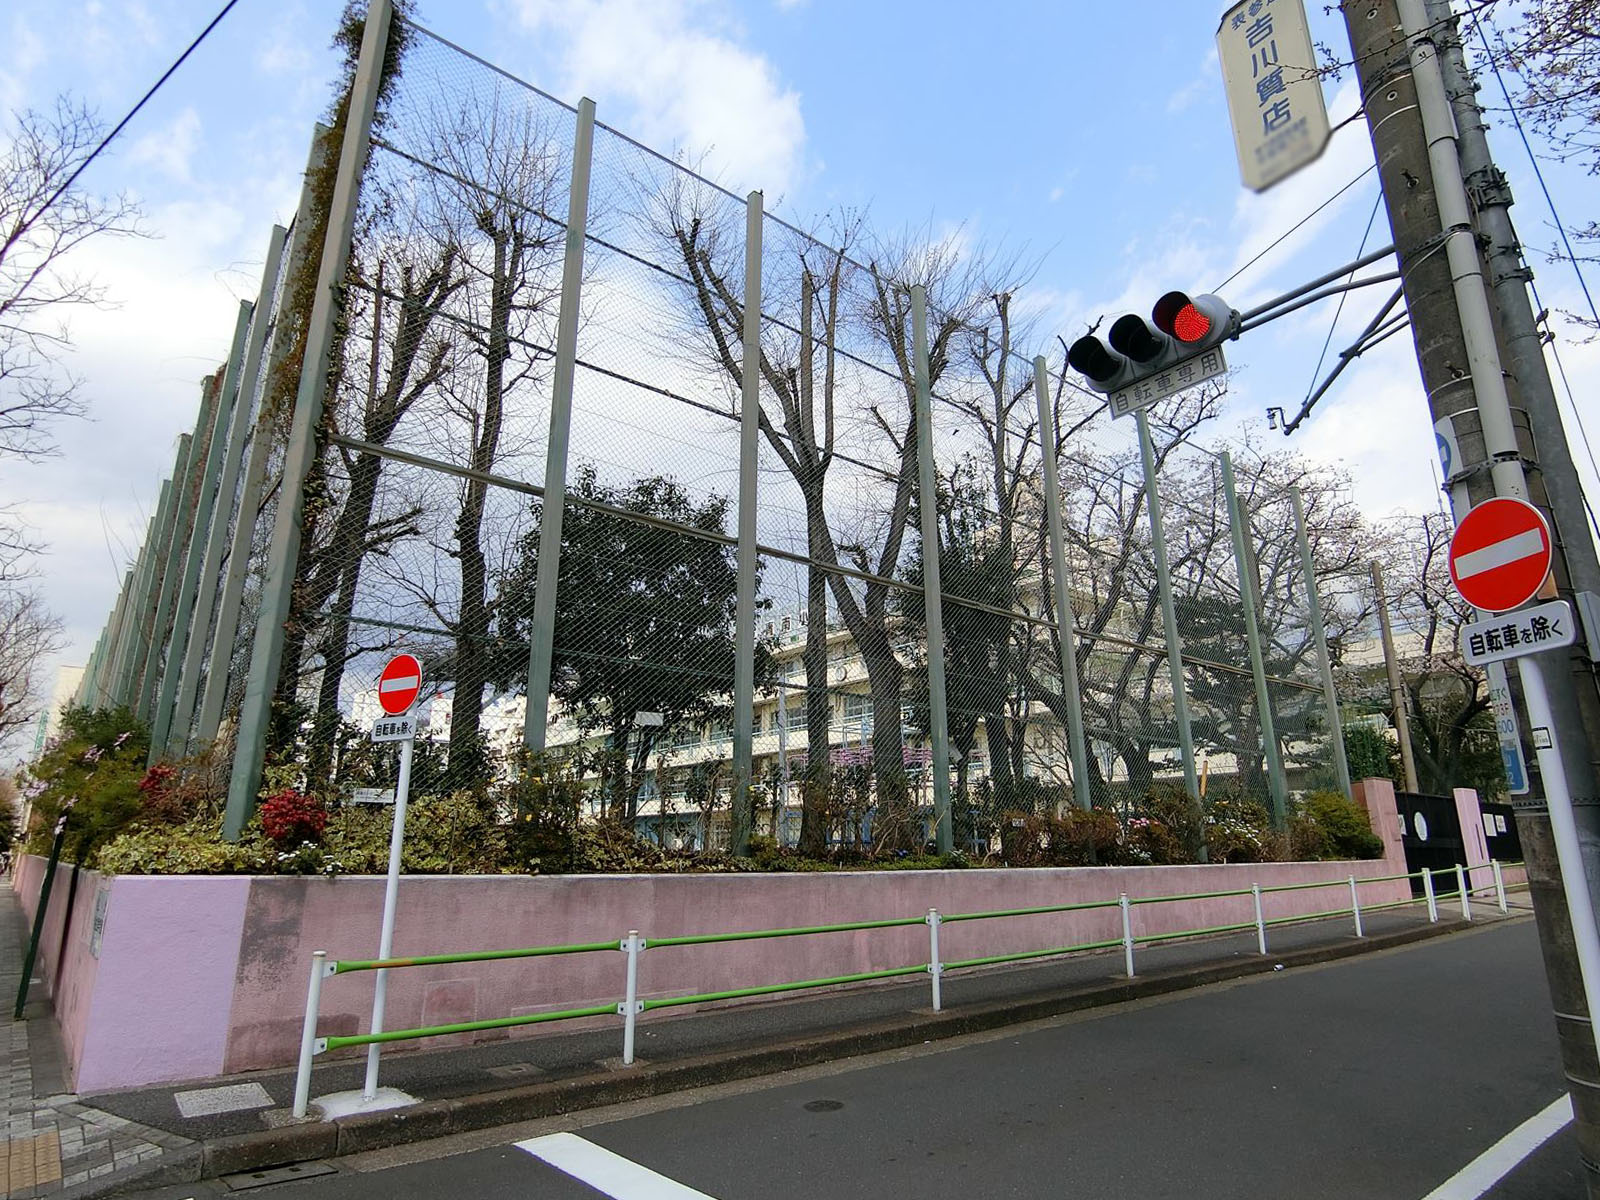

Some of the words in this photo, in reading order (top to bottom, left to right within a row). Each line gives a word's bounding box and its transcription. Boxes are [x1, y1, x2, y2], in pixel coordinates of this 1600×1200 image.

[1231, 0, 1275, 31] 表参
[1245, 12, 1292, 137] 吉川質店
[1115, 352, 1219, 412] 自転車専用
[1469, 615, 1564, 657] 自転車を除く
[375, 720, 413, 737] 自転車を除く
